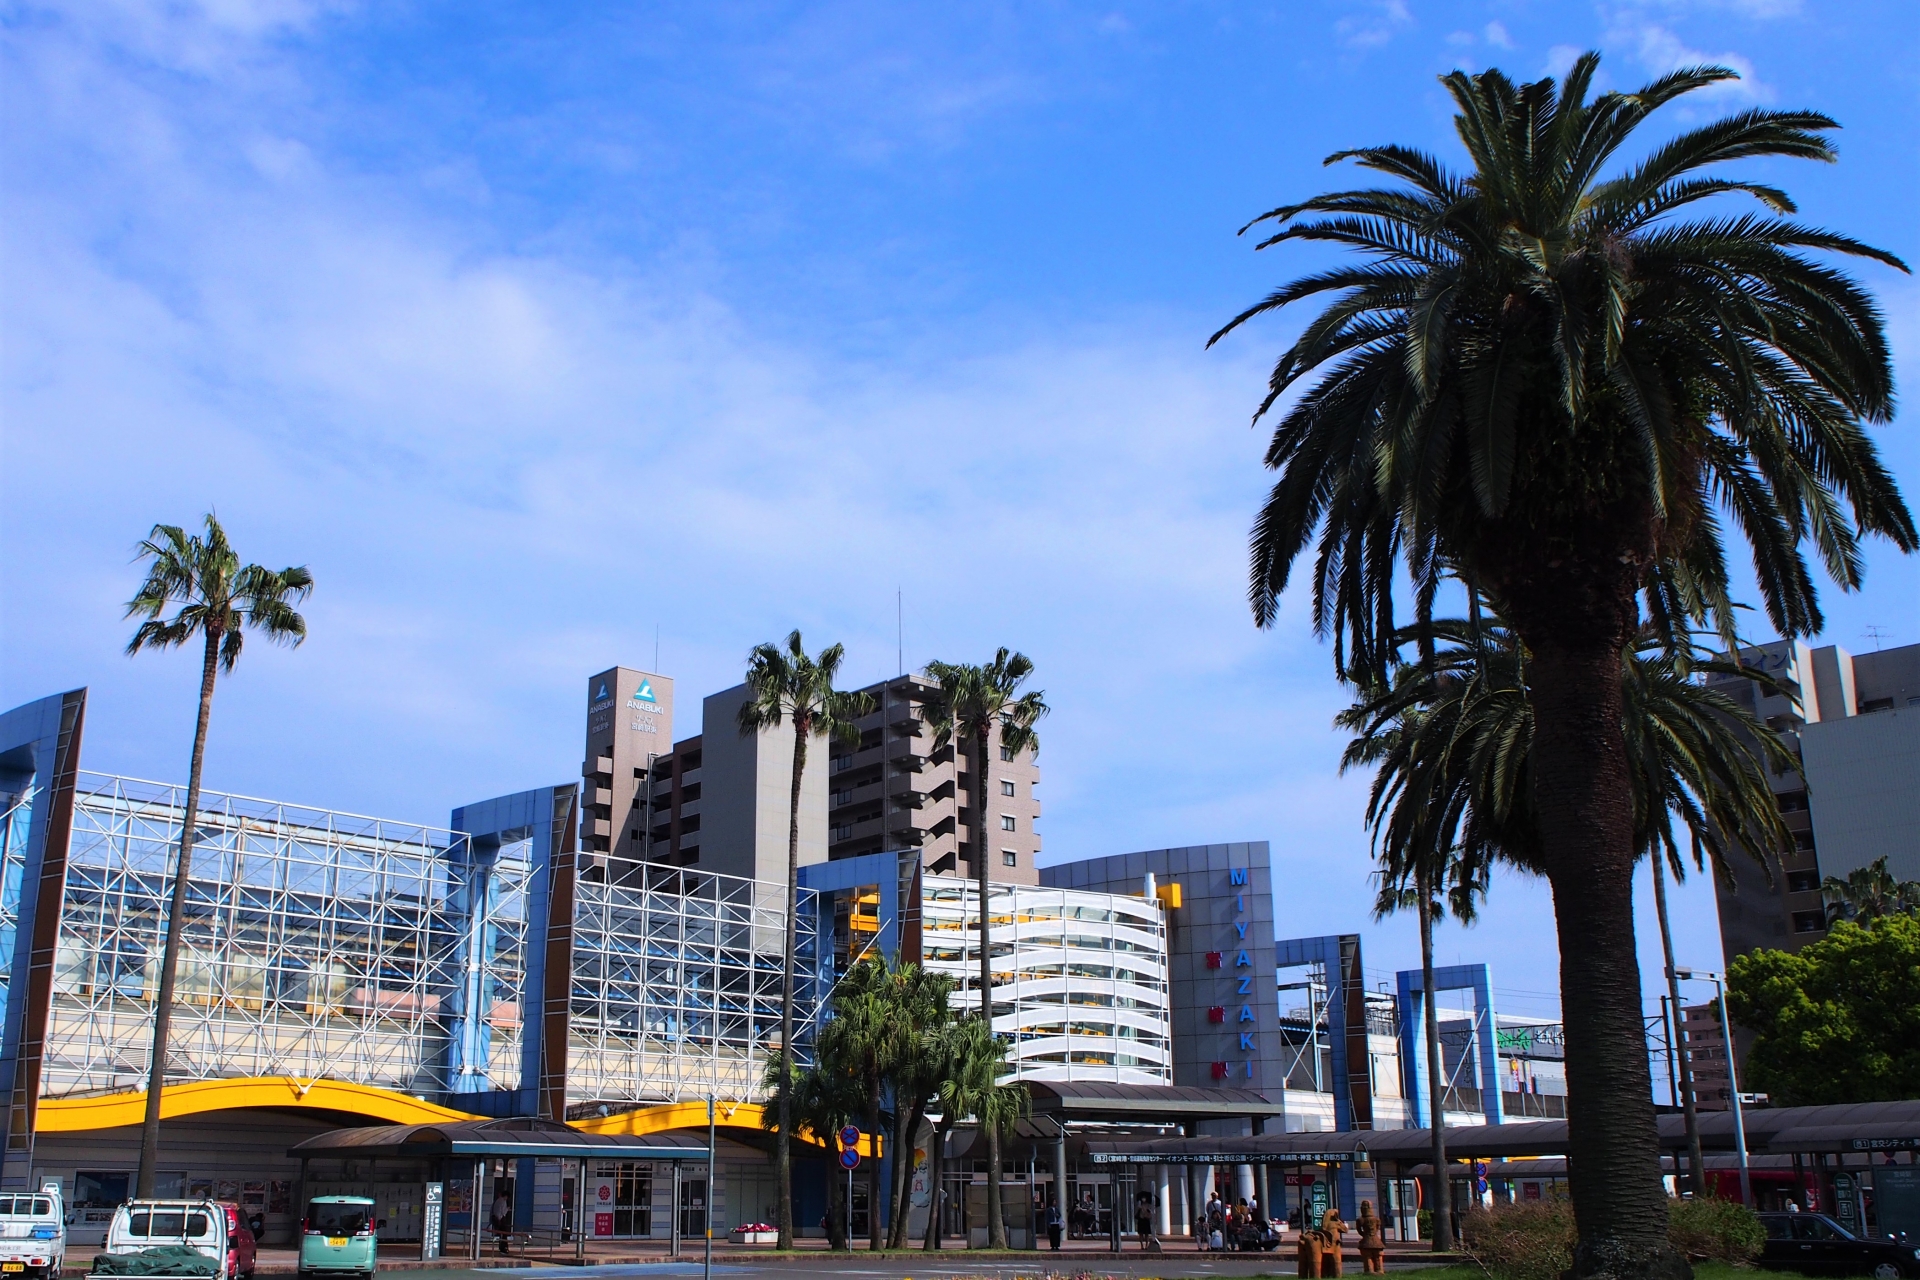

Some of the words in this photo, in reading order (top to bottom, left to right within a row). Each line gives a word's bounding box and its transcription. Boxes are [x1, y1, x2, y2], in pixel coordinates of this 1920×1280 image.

[589, 699, 614, 715] ANABUKI
[626, 700, 664, 715] ANABUKI
[1229, 867, 1256, 1079] MIYAZAKI
[1286, 1175, 1299, 1184] KFC
